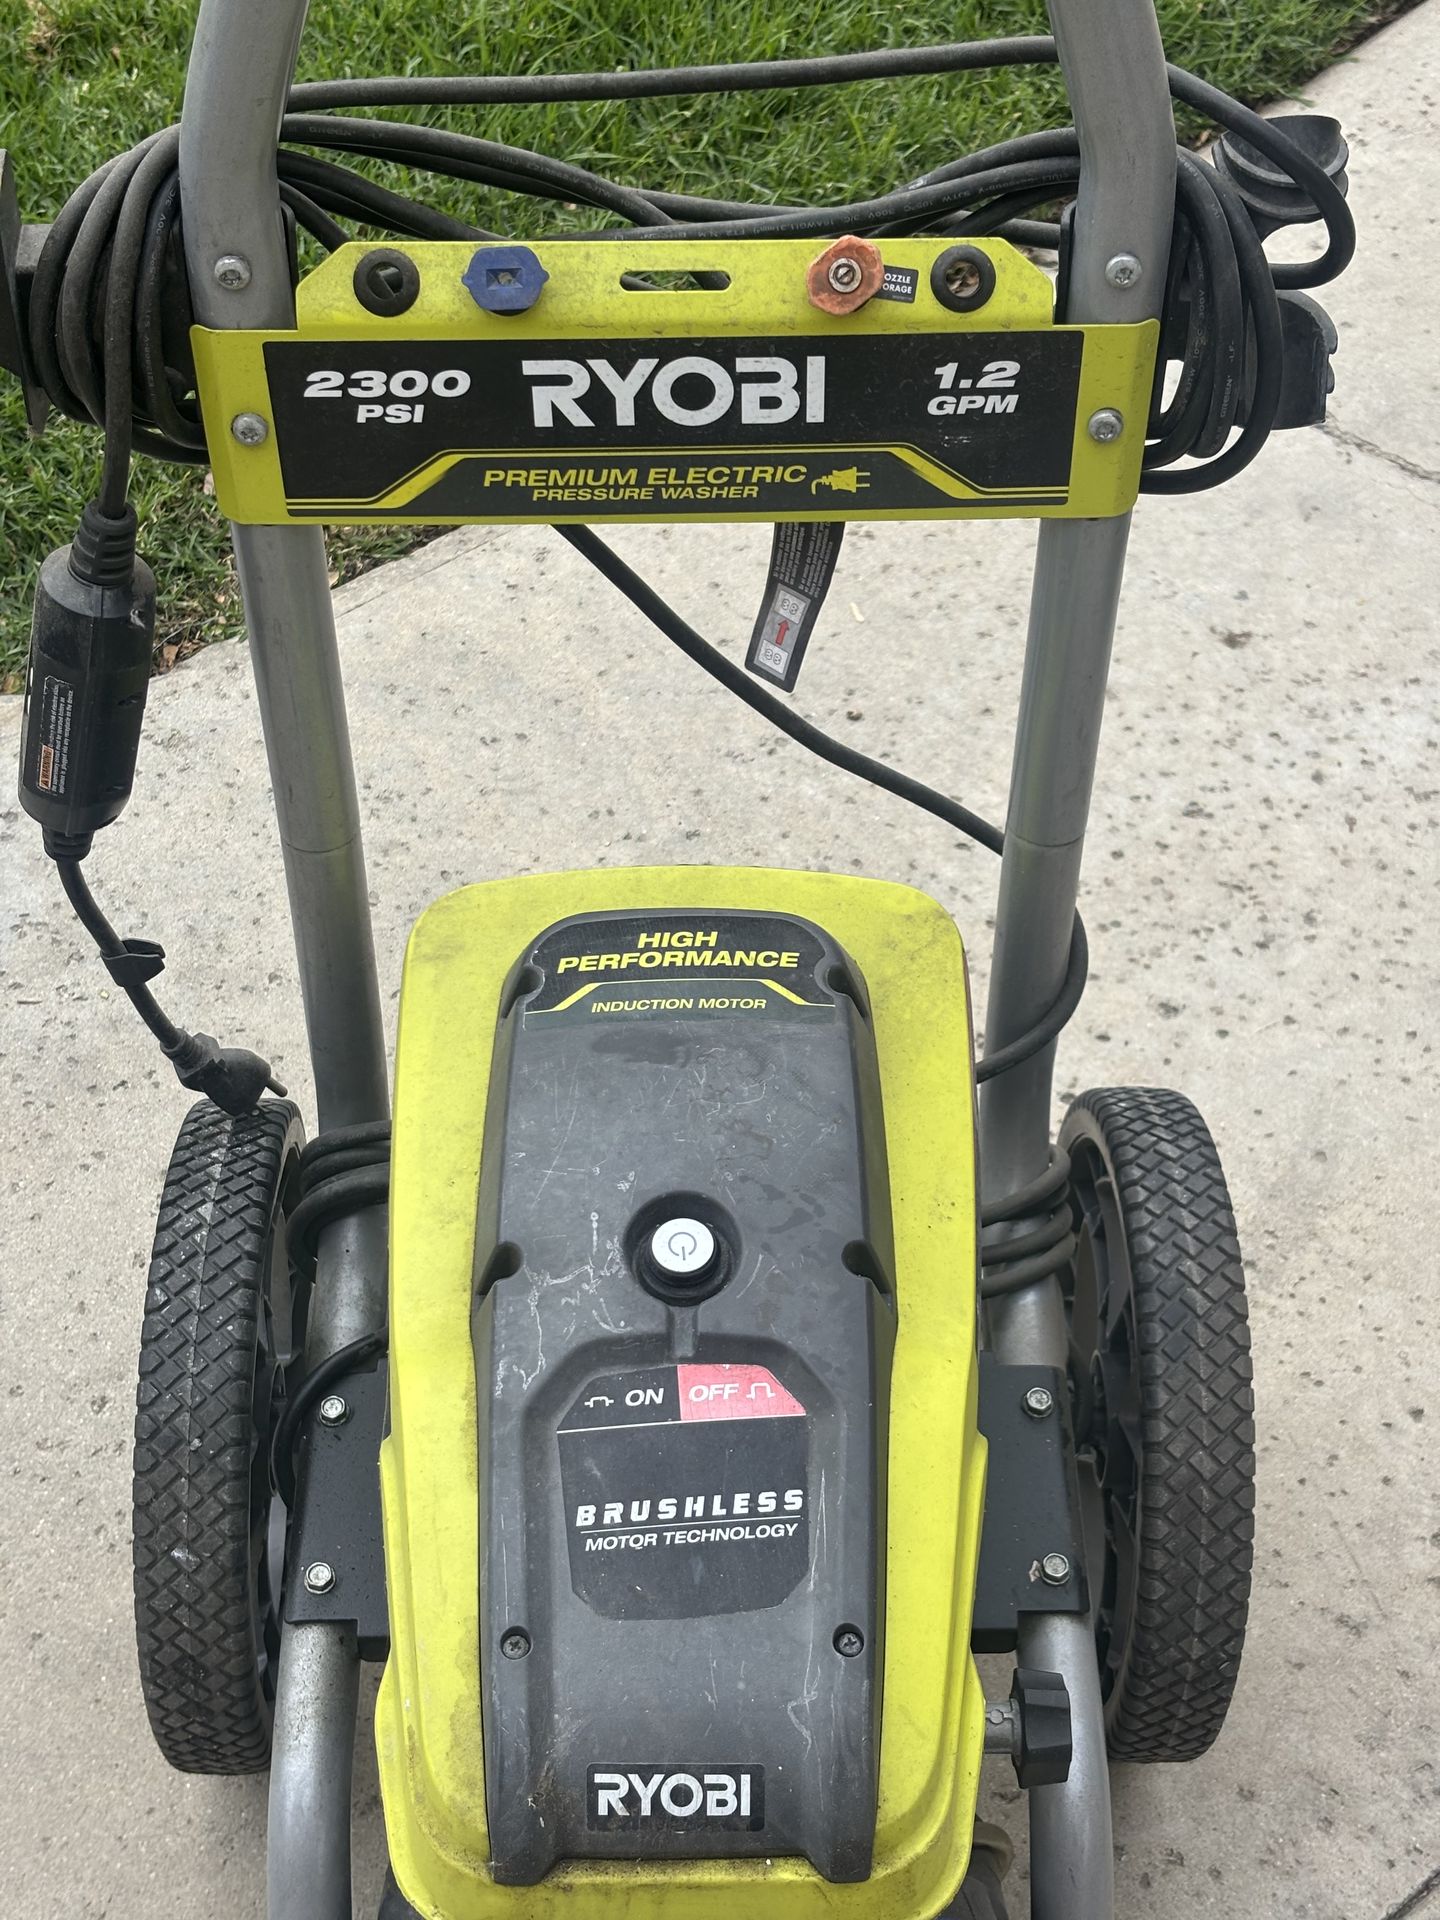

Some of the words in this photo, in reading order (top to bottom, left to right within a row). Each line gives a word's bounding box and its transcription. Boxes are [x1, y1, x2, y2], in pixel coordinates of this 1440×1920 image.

[882, 282, 913, 295] ORAGE
[883, 272, 911, 284] OZZLE
[303, 369, 471, 398] 2300
[933, 360, 1021, 390] 1.2
[522, 355, 826, 428] RYOBI
[356, 404, 425, 424] PSI
[926, 394, 1019, 416] GPM
[483, 468, 638, 487] PREMIUM
[647, 465, 808, 485] ELECTRIC
[532, 487, 655, 501] PRESSURE
[660, 486, 760, 499] WASHER
[637, 931, 719, 949] HIGH
[556, 950, 801, 974] PERFORMANCE
[591, 999, 694, 1014] INDUCTION
[699, 998, 767, 1010] MOTOR
[624, 1387, 665, 1406] ON
[688, 1383, 740, 1402] OFF
[575, 1488, 804, 1527] BRUSHLESS
[585, 1532, 658, 1551] MOTOR
[662, 1523, 799, 1545] TECHNOLOGY
[593, 1772, 751, 1817] RYOBI
